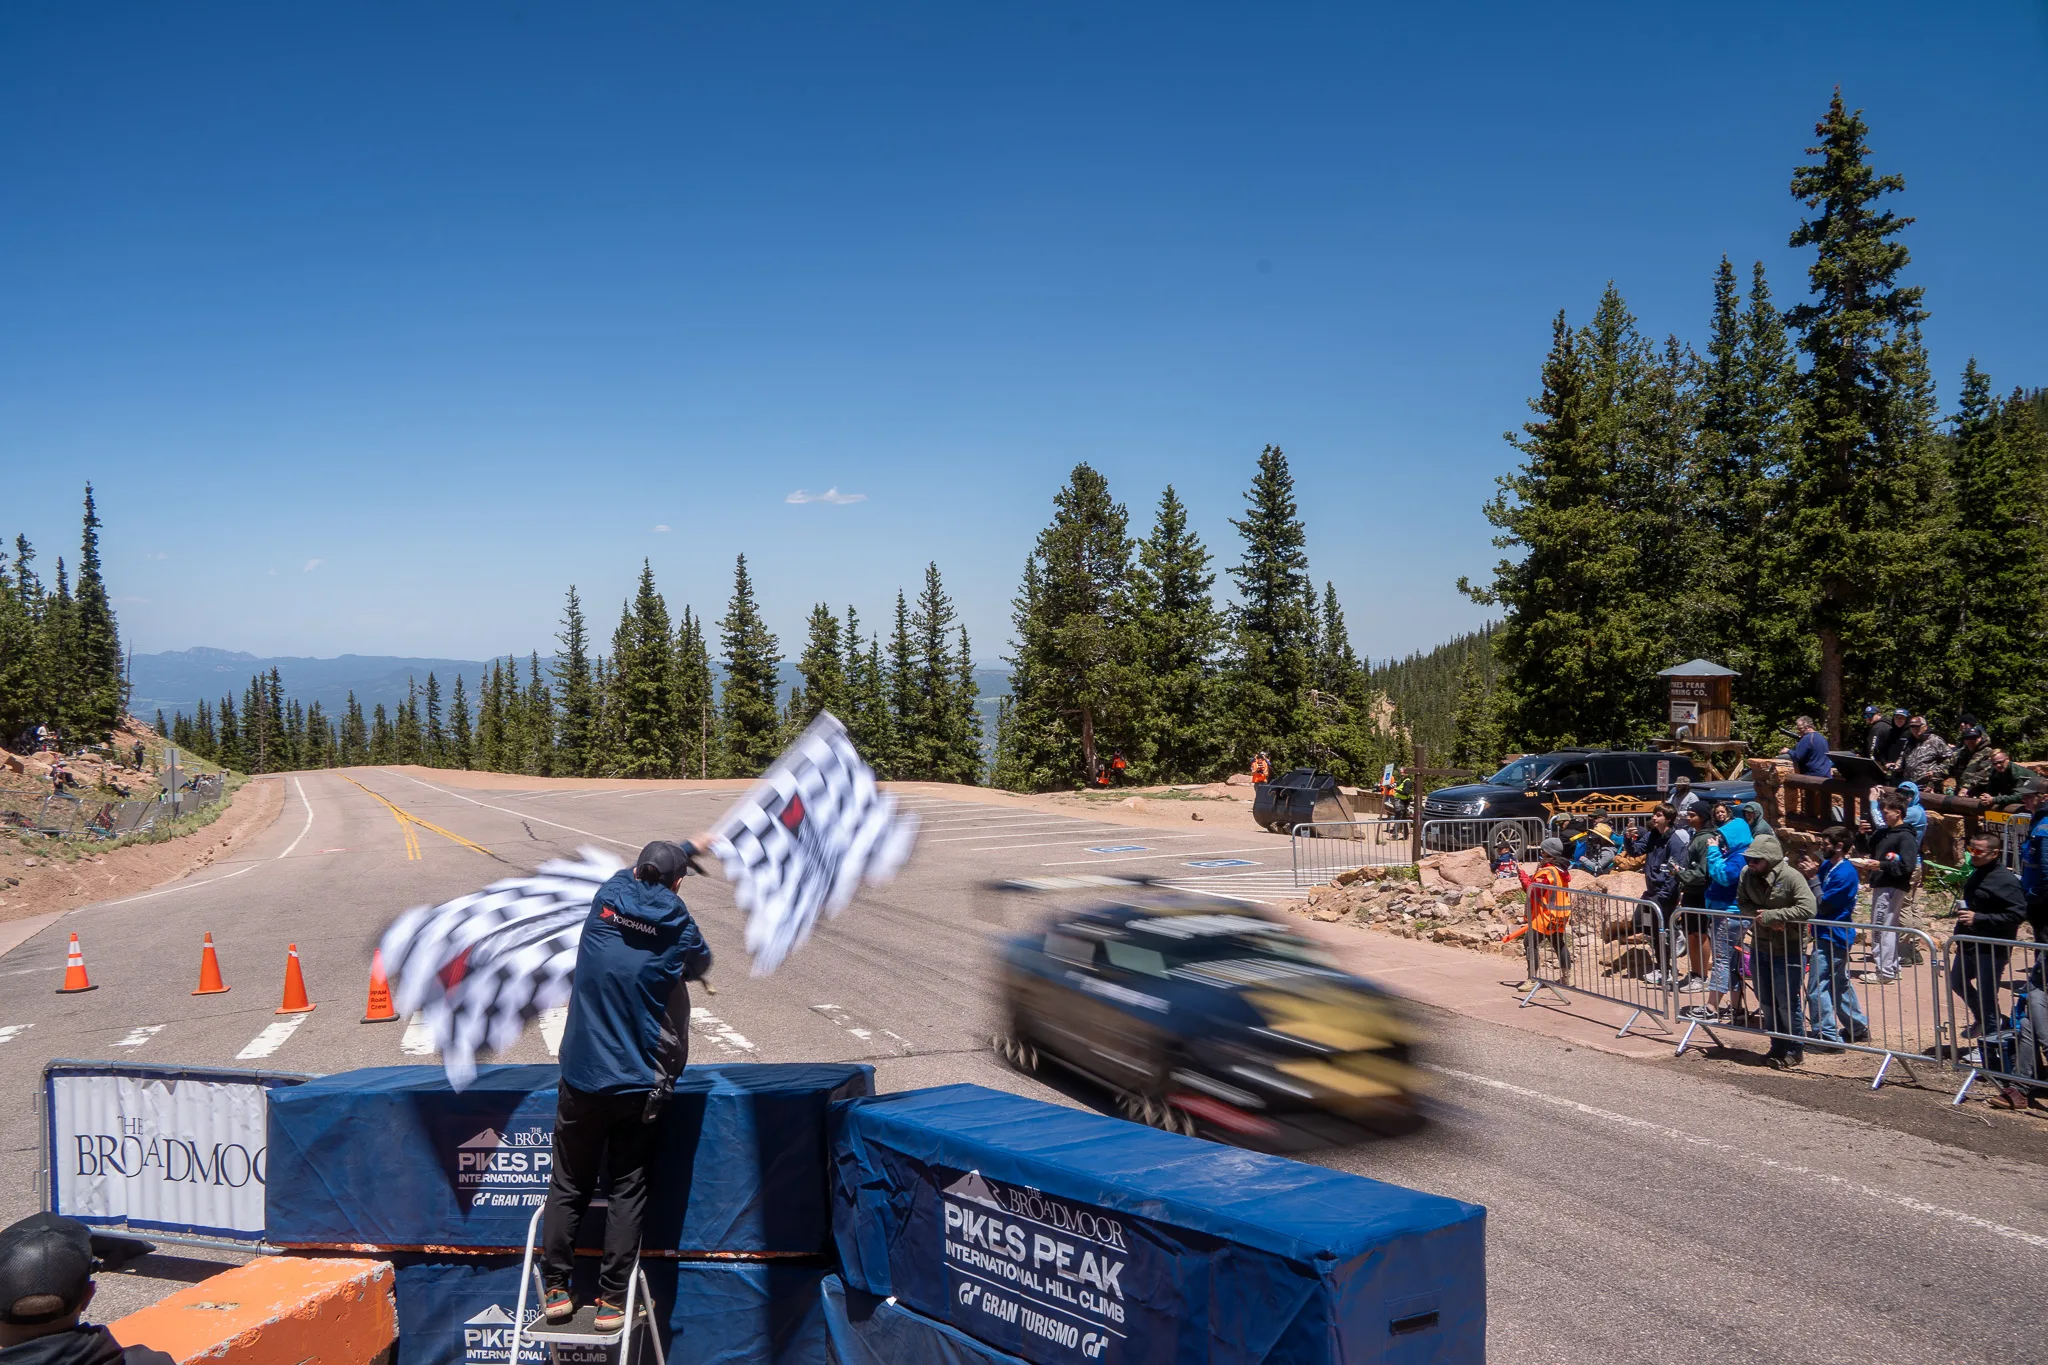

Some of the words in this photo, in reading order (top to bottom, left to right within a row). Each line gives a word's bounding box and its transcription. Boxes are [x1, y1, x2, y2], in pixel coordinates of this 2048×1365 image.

[1693, 689, 1708, 697] CO.
[1553, 803, 1644, 813] SHERIFF
[613, 913, 657, 935] YOKOHAMA
[117, 1116, 144, 1136] THE
[74, 1134, 267, 1188] BROADMO
[458, 1152, 529, 1172] PIKES
[459, 1174, 540, 1183] INTERNATIONAL
[491, 1194, 520, 1206] GRAN
[522, 1194, 548, 1206] TURI
[1008, 1188, 1126, 1248] BROADMOOR
[944, 1201, 1027, 1262] PIKES
[1034, 1234, 1125, 1301] PEAK
[945, 1239, 1043, 1291] INTERNATIONAL
[1045, 1280, 1078, 1304] HILL
[1079, 1291, 1125, 1324] CLIMB
[982, 1292, 1018, 1324] GRAN
[1020, 1307, 1079, 1349] TURISMO
[466, 1350, 546, 1361] INTERNAONAL
[572, 1352, 607, 1362] CLIMB
